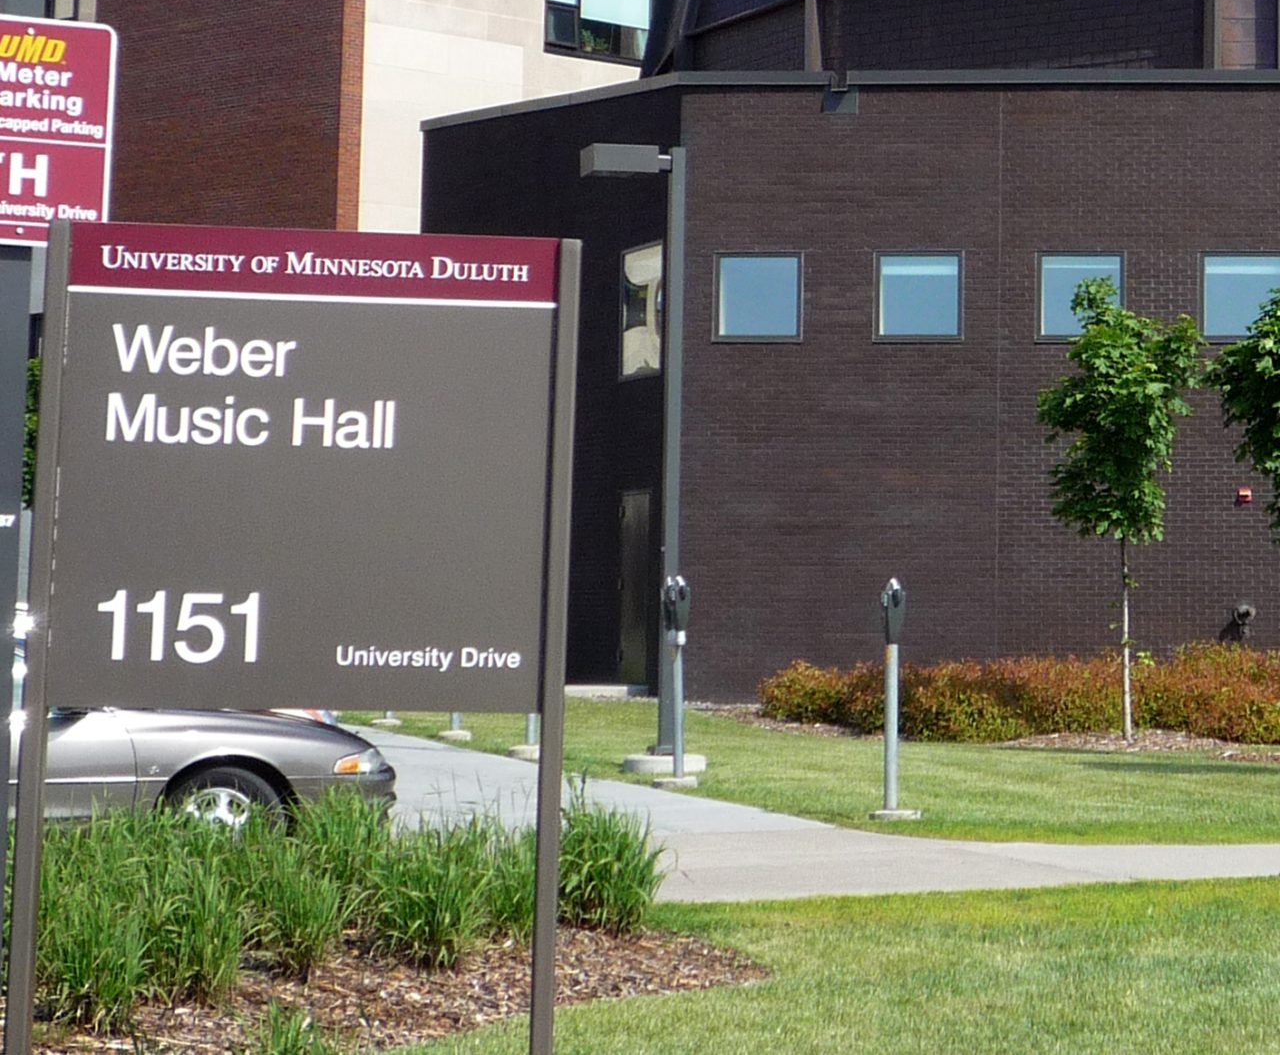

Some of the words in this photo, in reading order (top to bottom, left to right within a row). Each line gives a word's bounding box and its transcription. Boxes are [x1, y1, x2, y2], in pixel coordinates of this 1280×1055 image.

[0, 34, 66, 63] UMD
[0, 60, 73, 87] Meter
[51, 118, 104, 139] Parking
[57, 204, 99, 221] Drive
[100, 245, 245, 273] UNIVERSITY
[251, 256, 279, 274] OF
[284, 251, 425, 279] MINNESOTA
[430, 256, 529, 283] DULUTH
[112, 323, 297, 377] Weber
[105, 392, 270, 446] Music
[291, 398, 396, 449] Hall
[97, 589, 260, 664] 1151
[336, 645, 454, 672] University
[460, 647, 521, 668] Drive
